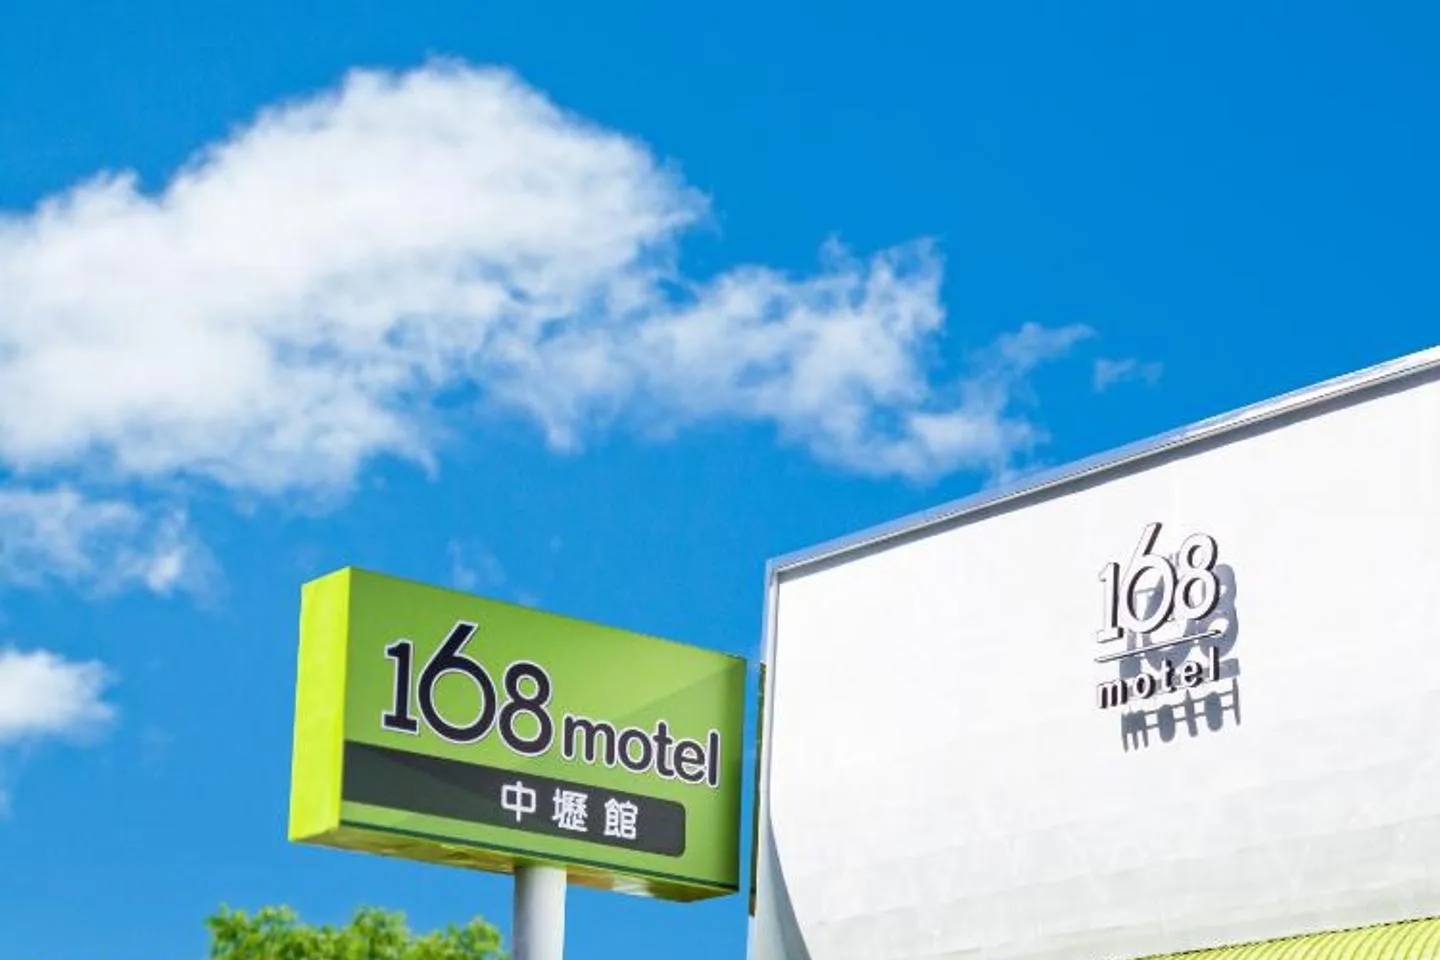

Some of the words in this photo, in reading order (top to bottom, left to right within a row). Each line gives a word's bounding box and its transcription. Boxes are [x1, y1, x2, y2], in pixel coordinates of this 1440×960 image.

[1097, 521, 1221, 644] 168
[382, 620, 555, 757] 168
[563, 713, 721, 788] motel
[1096, 646, 1220, 708] motel
[501, 780, 639, 840] 中壢館
